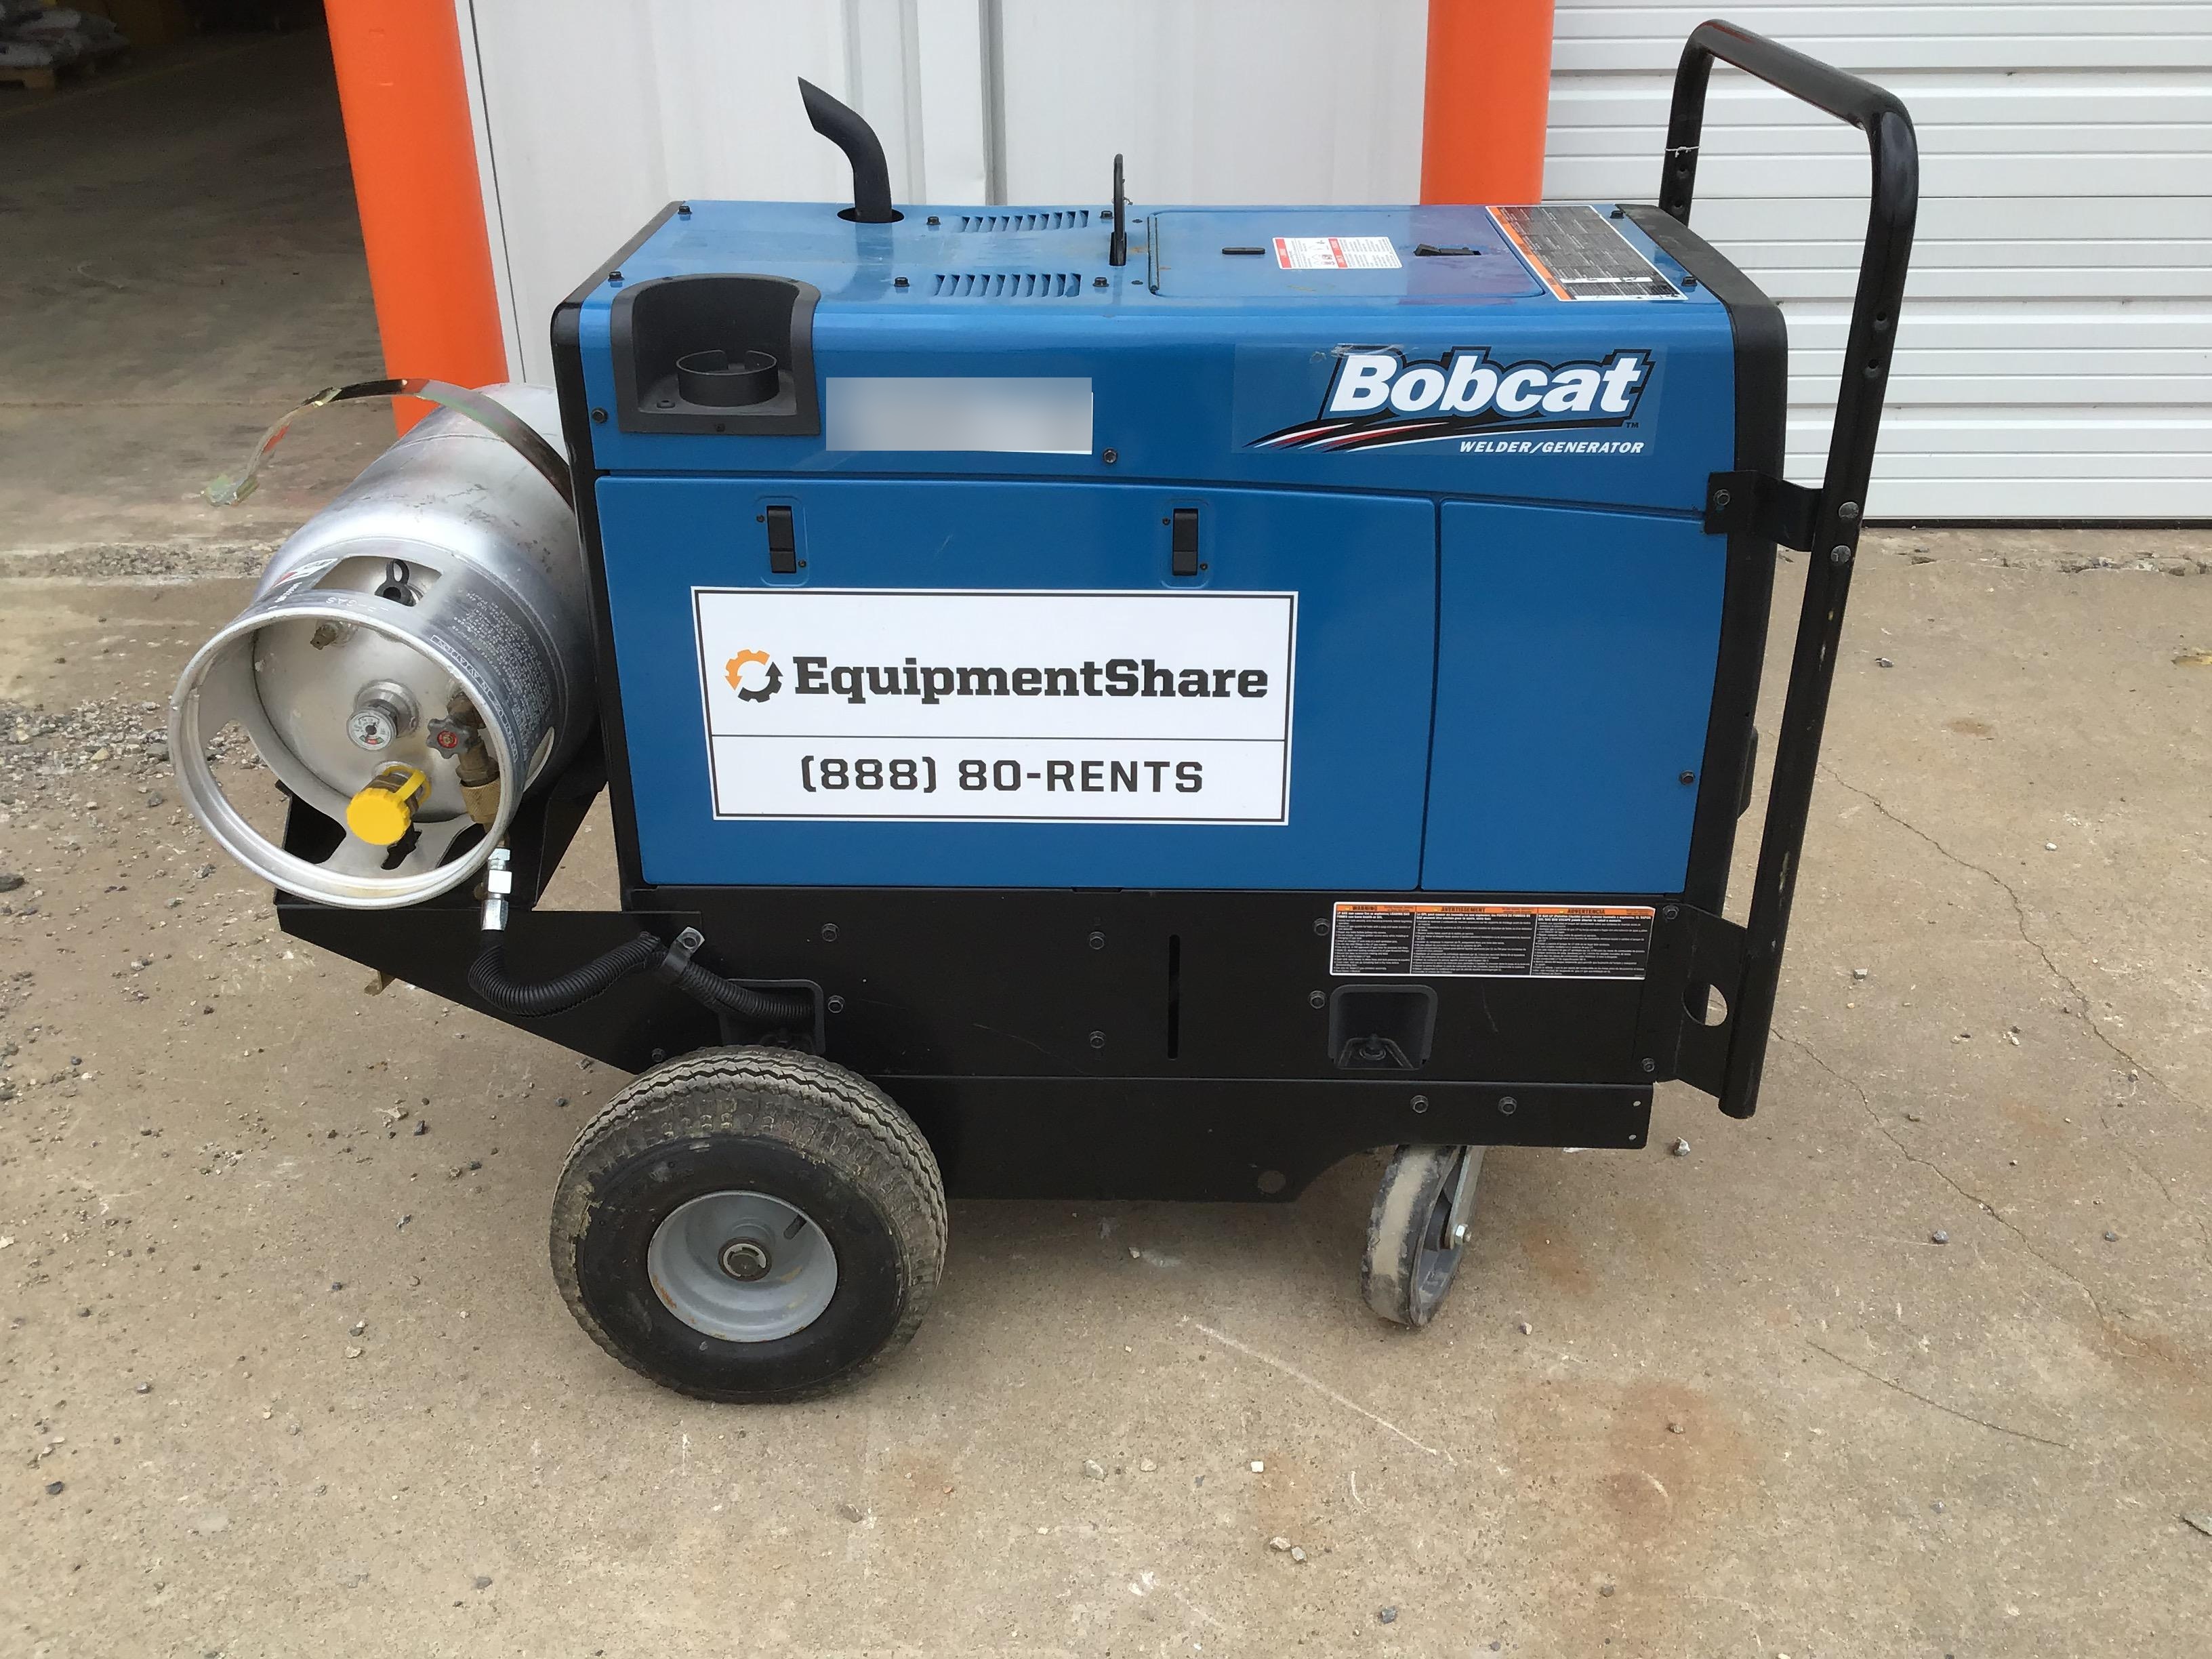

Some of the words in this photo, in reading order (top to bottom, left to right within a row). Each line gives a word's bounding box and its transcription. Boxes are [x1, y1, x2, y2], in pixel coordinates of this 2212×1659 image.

[1330, 354, 1642, 413] Bobcat
[1460, 441, 1645, 454] WELDER/GENERATOR
[793, 656, 1269, 705] EquipmentShare
[801, 755, 937, 794] (888)
[958, 760, 1204, 794] 80-RENTS
